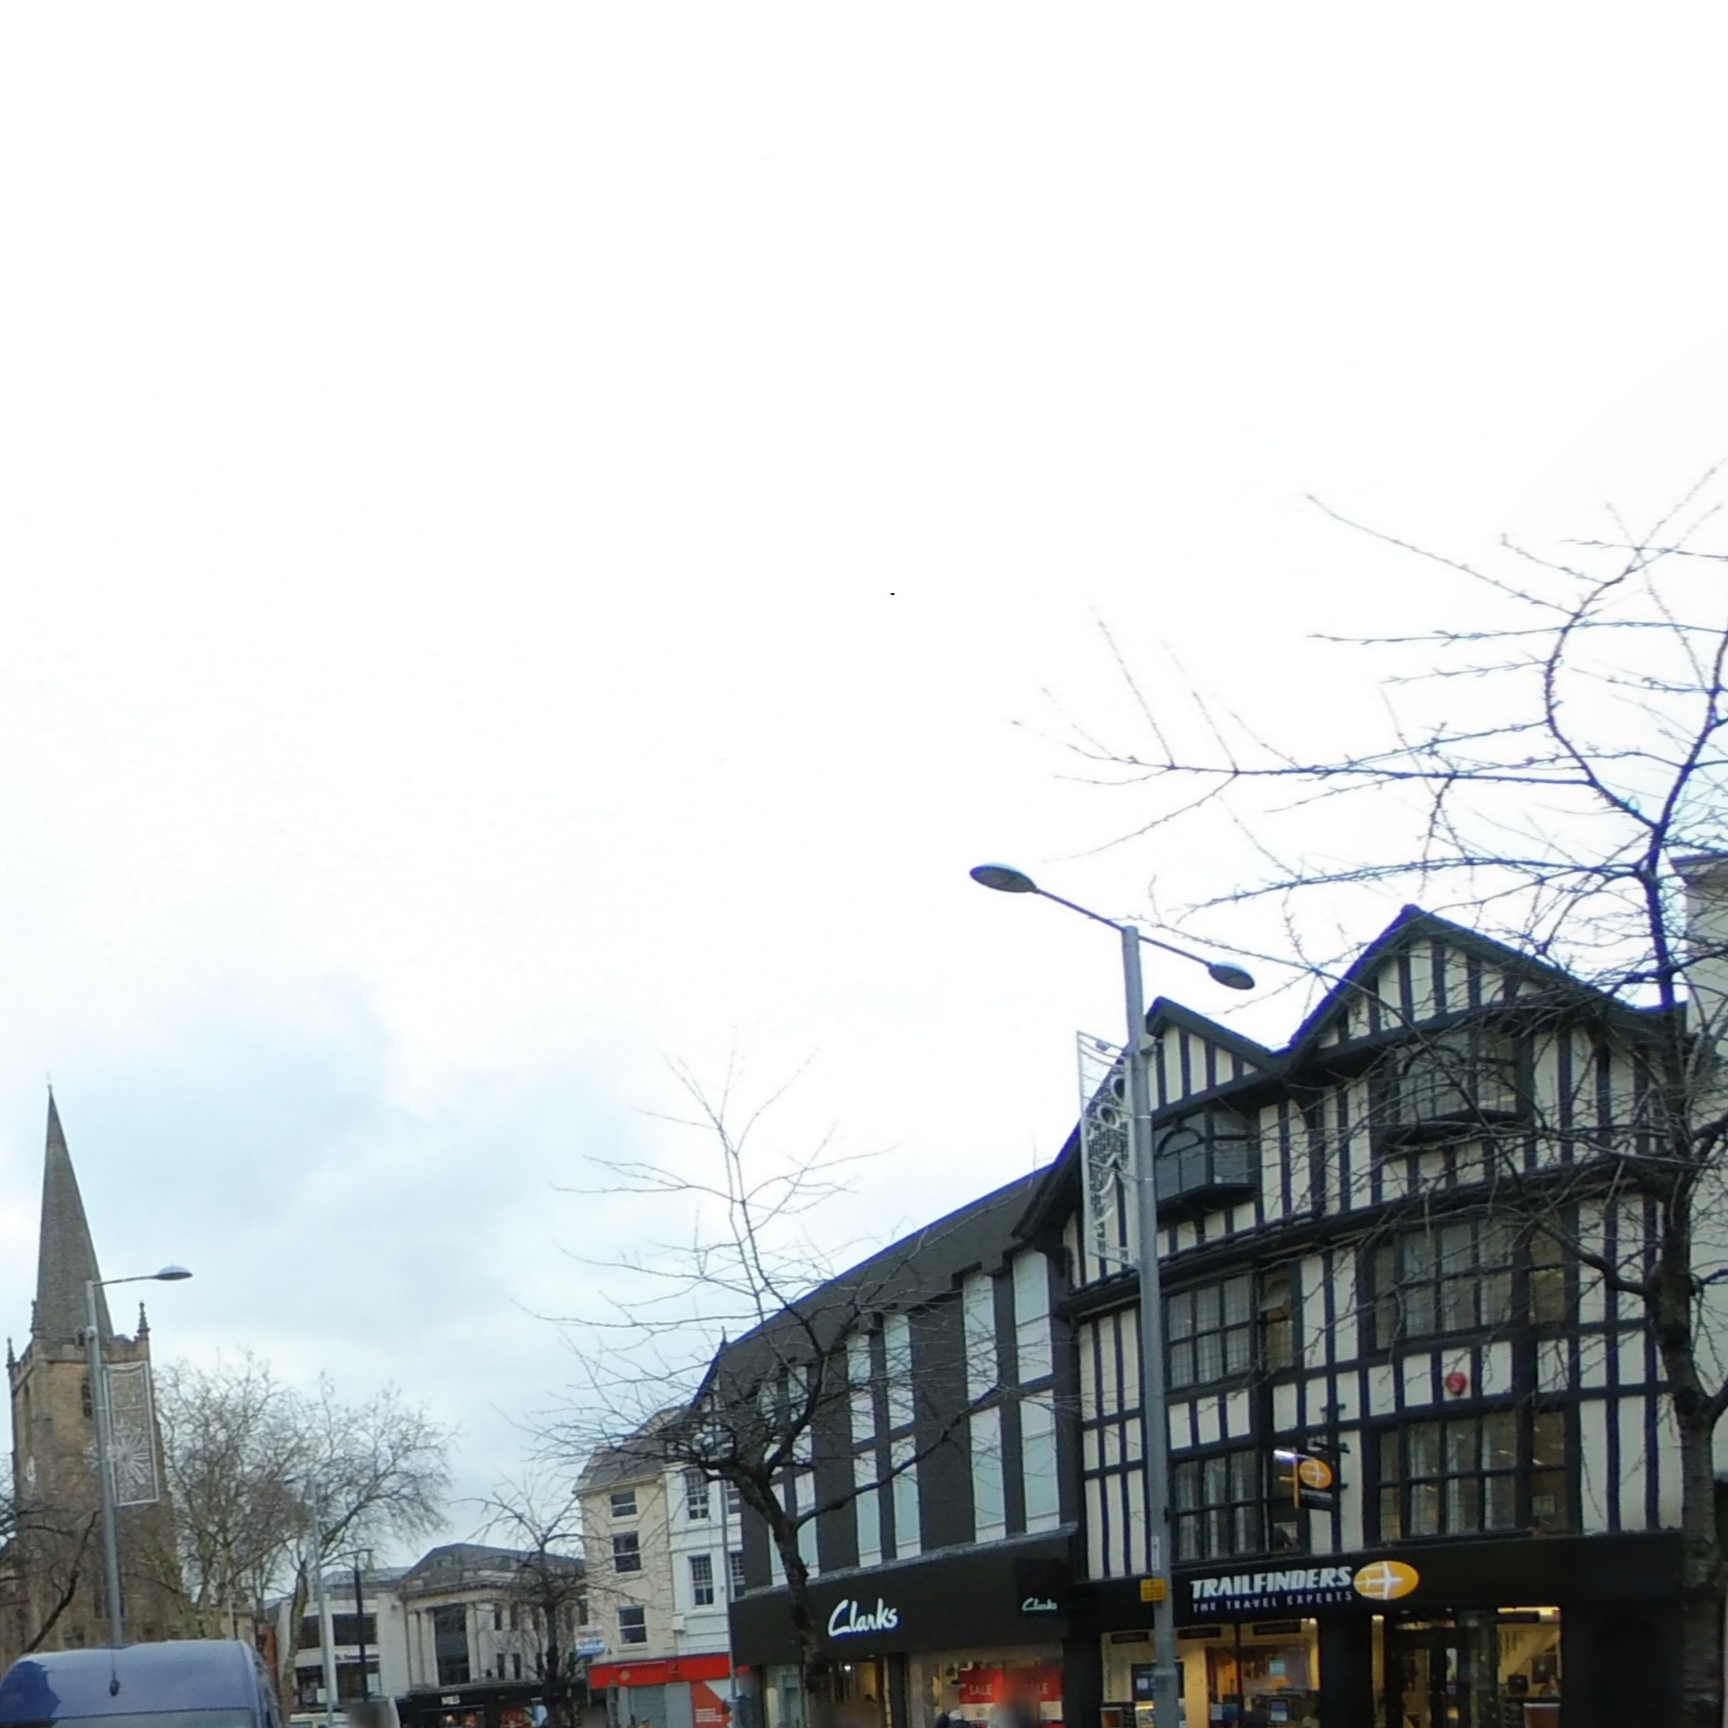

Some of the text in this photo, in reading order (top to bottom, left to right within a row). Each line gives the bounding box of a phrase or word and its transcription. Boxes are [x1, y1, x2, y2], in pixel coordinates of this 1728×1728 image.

[1190, 1566, 1353, 1600] TRAILFINDERS
[1021, 1597, 1058, 1612] Clarks
[1192, 1590, 1353, 1613] THE TRAVEL EXPERTS
[827, 1597, 899, 1638] Clarks
[968, 1682, 993, 1697] SALE
